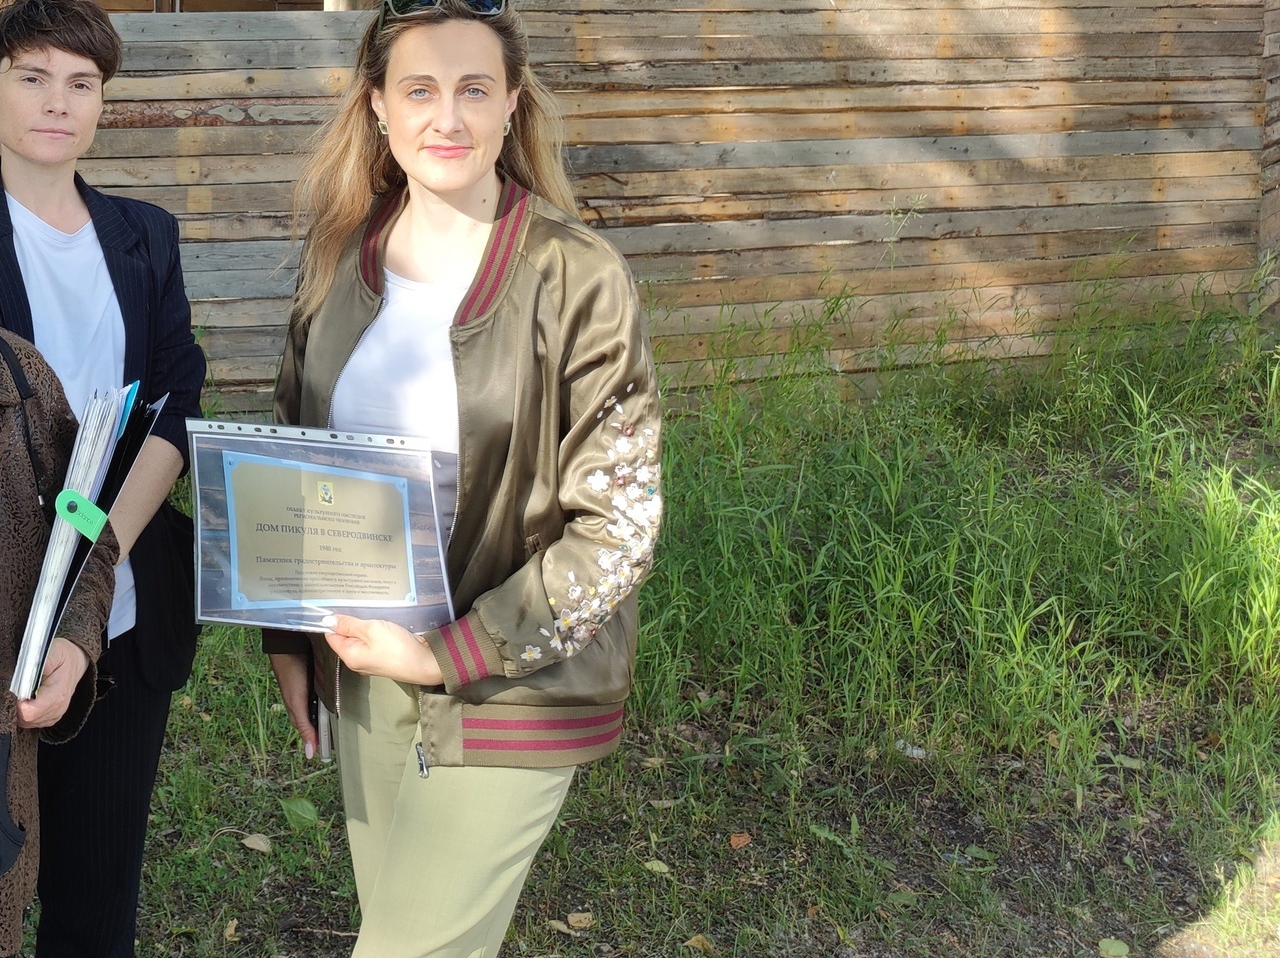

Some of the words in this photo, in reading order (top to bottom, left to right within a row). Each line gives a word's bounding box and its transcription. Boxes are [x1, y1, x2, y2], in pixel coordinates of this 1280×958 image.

[255, 523, 279, 533] ДОМ
[280, 525, 319, 536] ПИКУЛЯ
[320, 528, 326, 536] В
[327, 529, 393, 542] СЕВЕРОДВИНСКЕ
